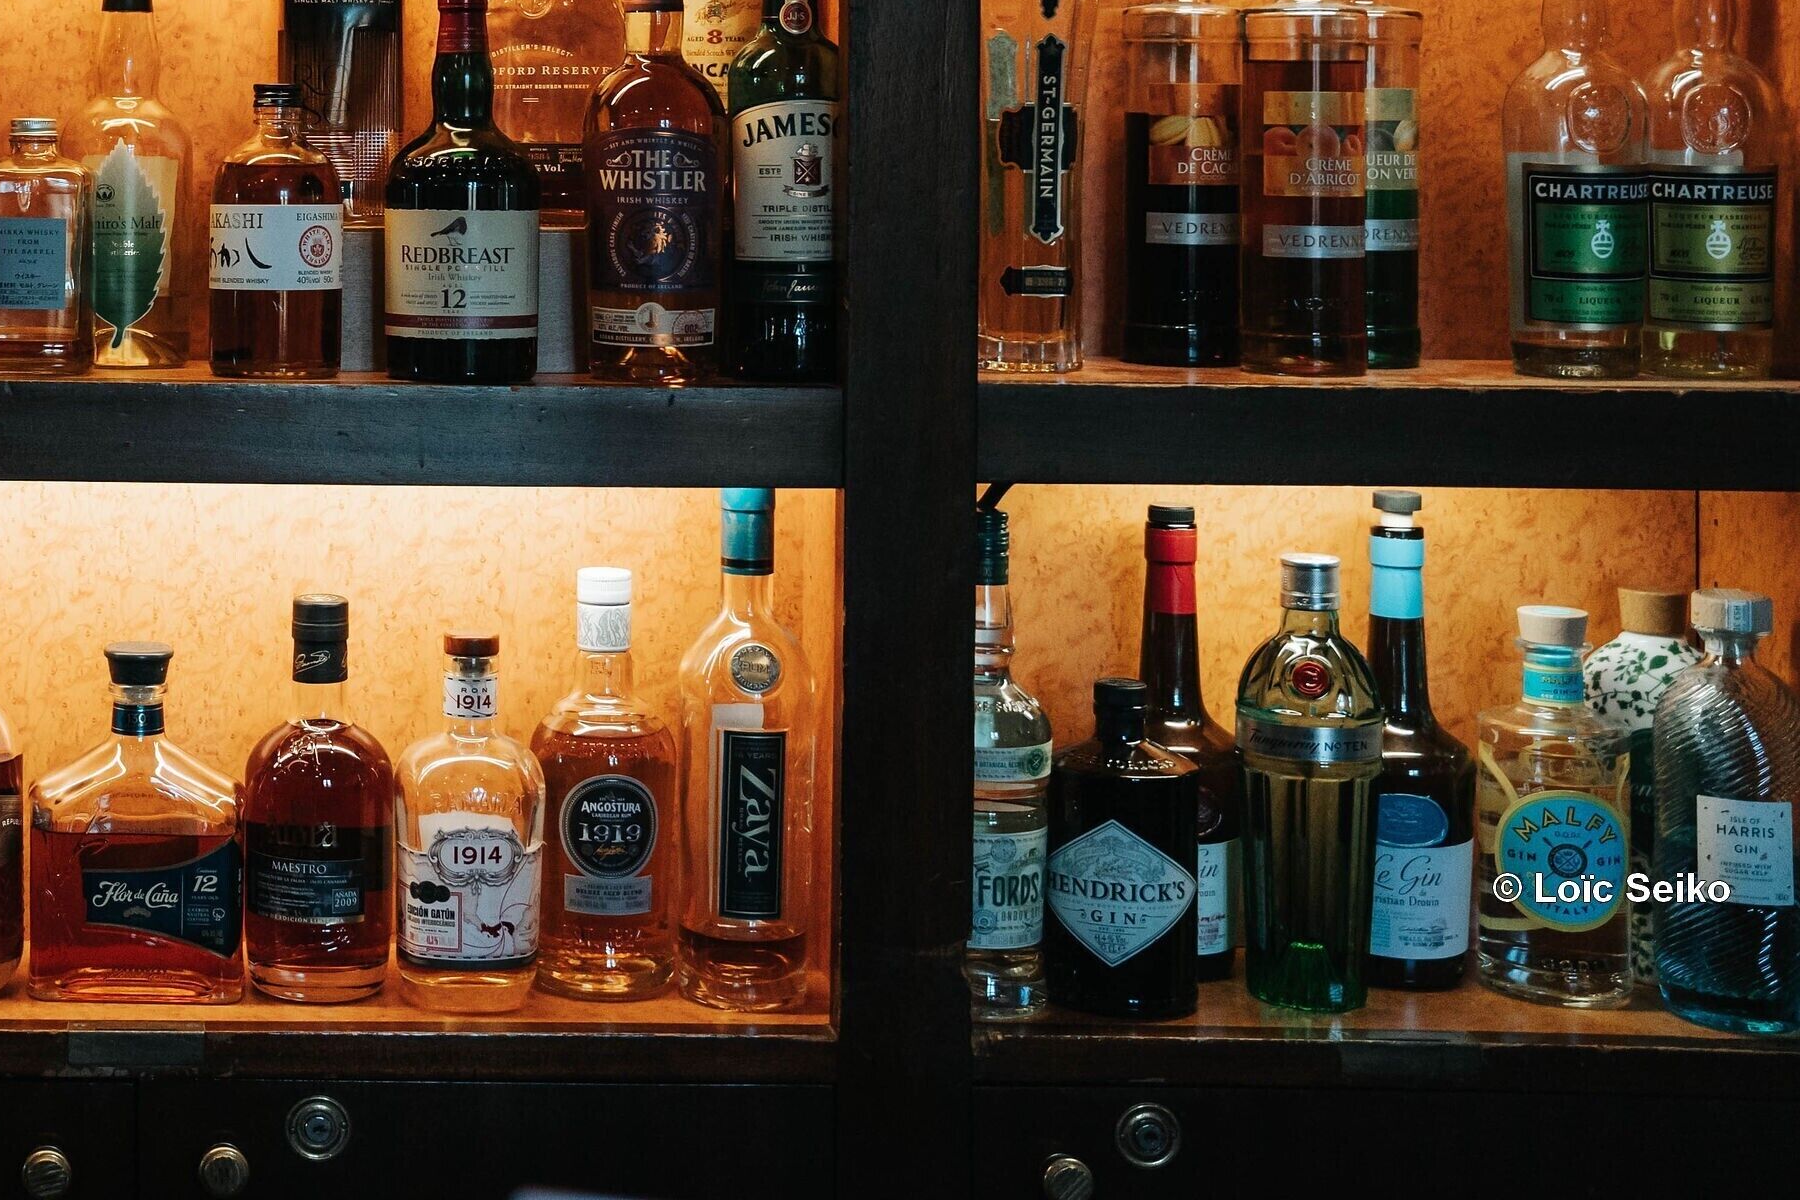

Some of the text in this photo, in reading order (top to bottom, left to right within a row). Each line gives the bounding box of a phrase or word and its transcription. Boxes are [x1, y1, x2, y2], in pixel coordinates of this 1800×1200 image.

[706, 29, 723, 44] 8
[542, 65, 610, 75] RESERVE
[631, 150, 672, 168] THE
[1306, 157, 1352, 172] CRÈME
[1177, 162, 1196, 175] DE
[599, 169, 706, 192] WHISTLER
[1289, 171, 1361, 185] D'ABRICOT
[1535, 182, 1648, 199] CHARTREUSE
[1652, 182, 1773, 199] CHARTREUSE
[616, 196, 642, 204] IRISH
[762, 205, 797, 213] TRIPLE
[130, 216, 161, 230] Malt
[401, 244, 515, 265] REDBREAST
[428, 273, 446, 281] Irish
[441, 288, 467, 309] 12
[1693, 297, 1741, 305] LIQUEUR
[456, 695, 491, 710] 1914
[1250, 728, 1368, 753] Tanqueray TEN
[581, 800, 641, 814] ANGOSTURA
[731, 764, 777, 879] Zaya
[1514, 807, 1617, 844] MALFY
[579, 822, 641, 842] 1919
[1716, 823, 1775, 838] HARRIS
[453, 846, 502, 865] 1914
[1508, 849, 1537, 862] GIN
[1734, 844, 1758, 855] GIN
[271, 860, 327, 875] MAESTRO
[1596, 856, 1621, 866] GIN
[1398, 855, 1442, 896] Gin
[192, 875, 218, 893] 12
[978, 872, 1039, 909] FORDS
[1049, 871, 1185, 902] HENDRICK'S
[92, 881, 179, 909] Flor de Caña
[335, 890, 357, 898] AÑADA
[1408, 896, 1439, 907] Drouin
[334, 898, 357, 907] 2009
[430, 905, 455, 920] GATÚN
[996, 909, 1028, 922] LONDON
[1090, 910, 1137, 925] GIN
